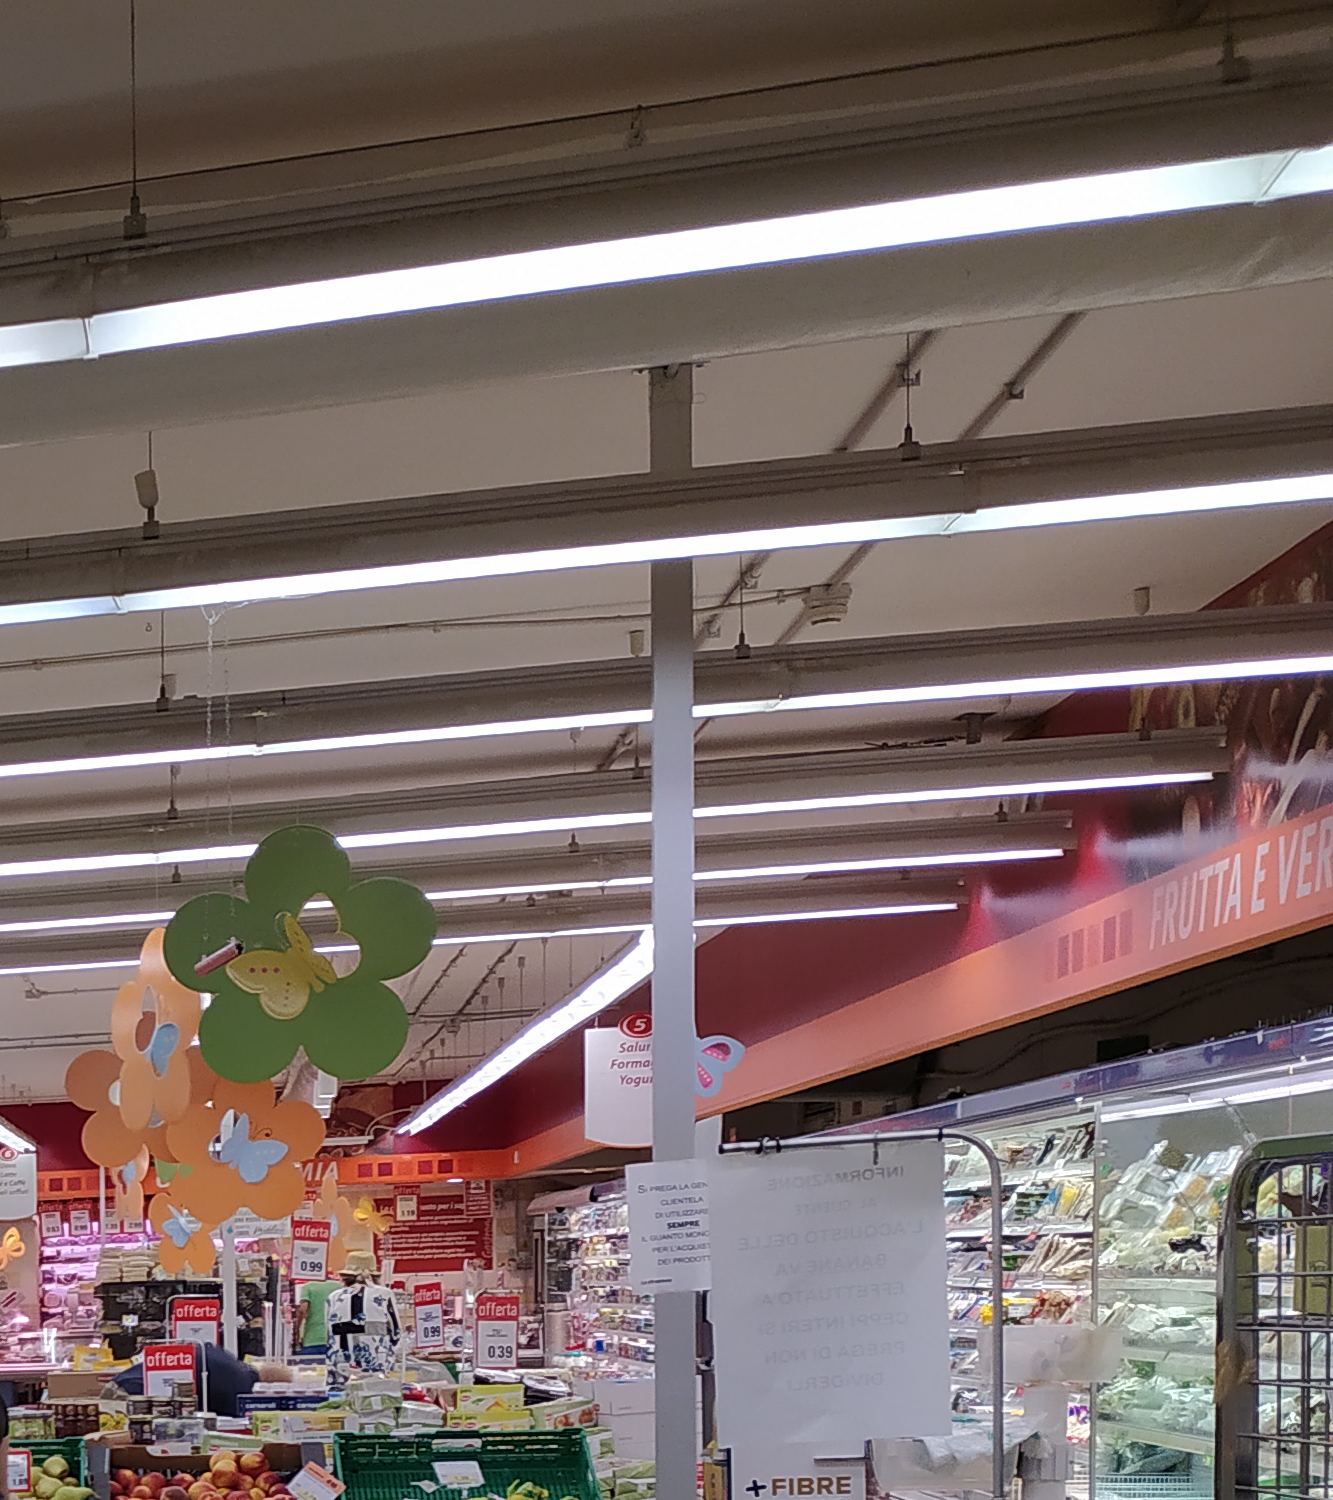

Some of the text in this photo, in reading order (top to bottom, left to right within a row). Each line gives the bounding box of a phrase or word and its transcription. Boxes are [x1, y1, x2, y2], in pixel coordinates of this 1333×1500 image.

[1149, 854, 1241, 951] FRUTTA
[1250, 841, 1268, 914] E
[634, 1018, 647, 1031] 5
[610, 1059, 653, 1070] Forma
[667, 1220, 700, 1229] SEMPRE
[294, 1225, 329, 1238] offerta
[415, 1289, 440, 1303] offerta
[176, 1305, 218, 1318] offerta
[478, 1303, 517, 1316] offerta
[146, 1352, 193, 1367] offerta
[771, 1476, 852, 1496] FIBRE
